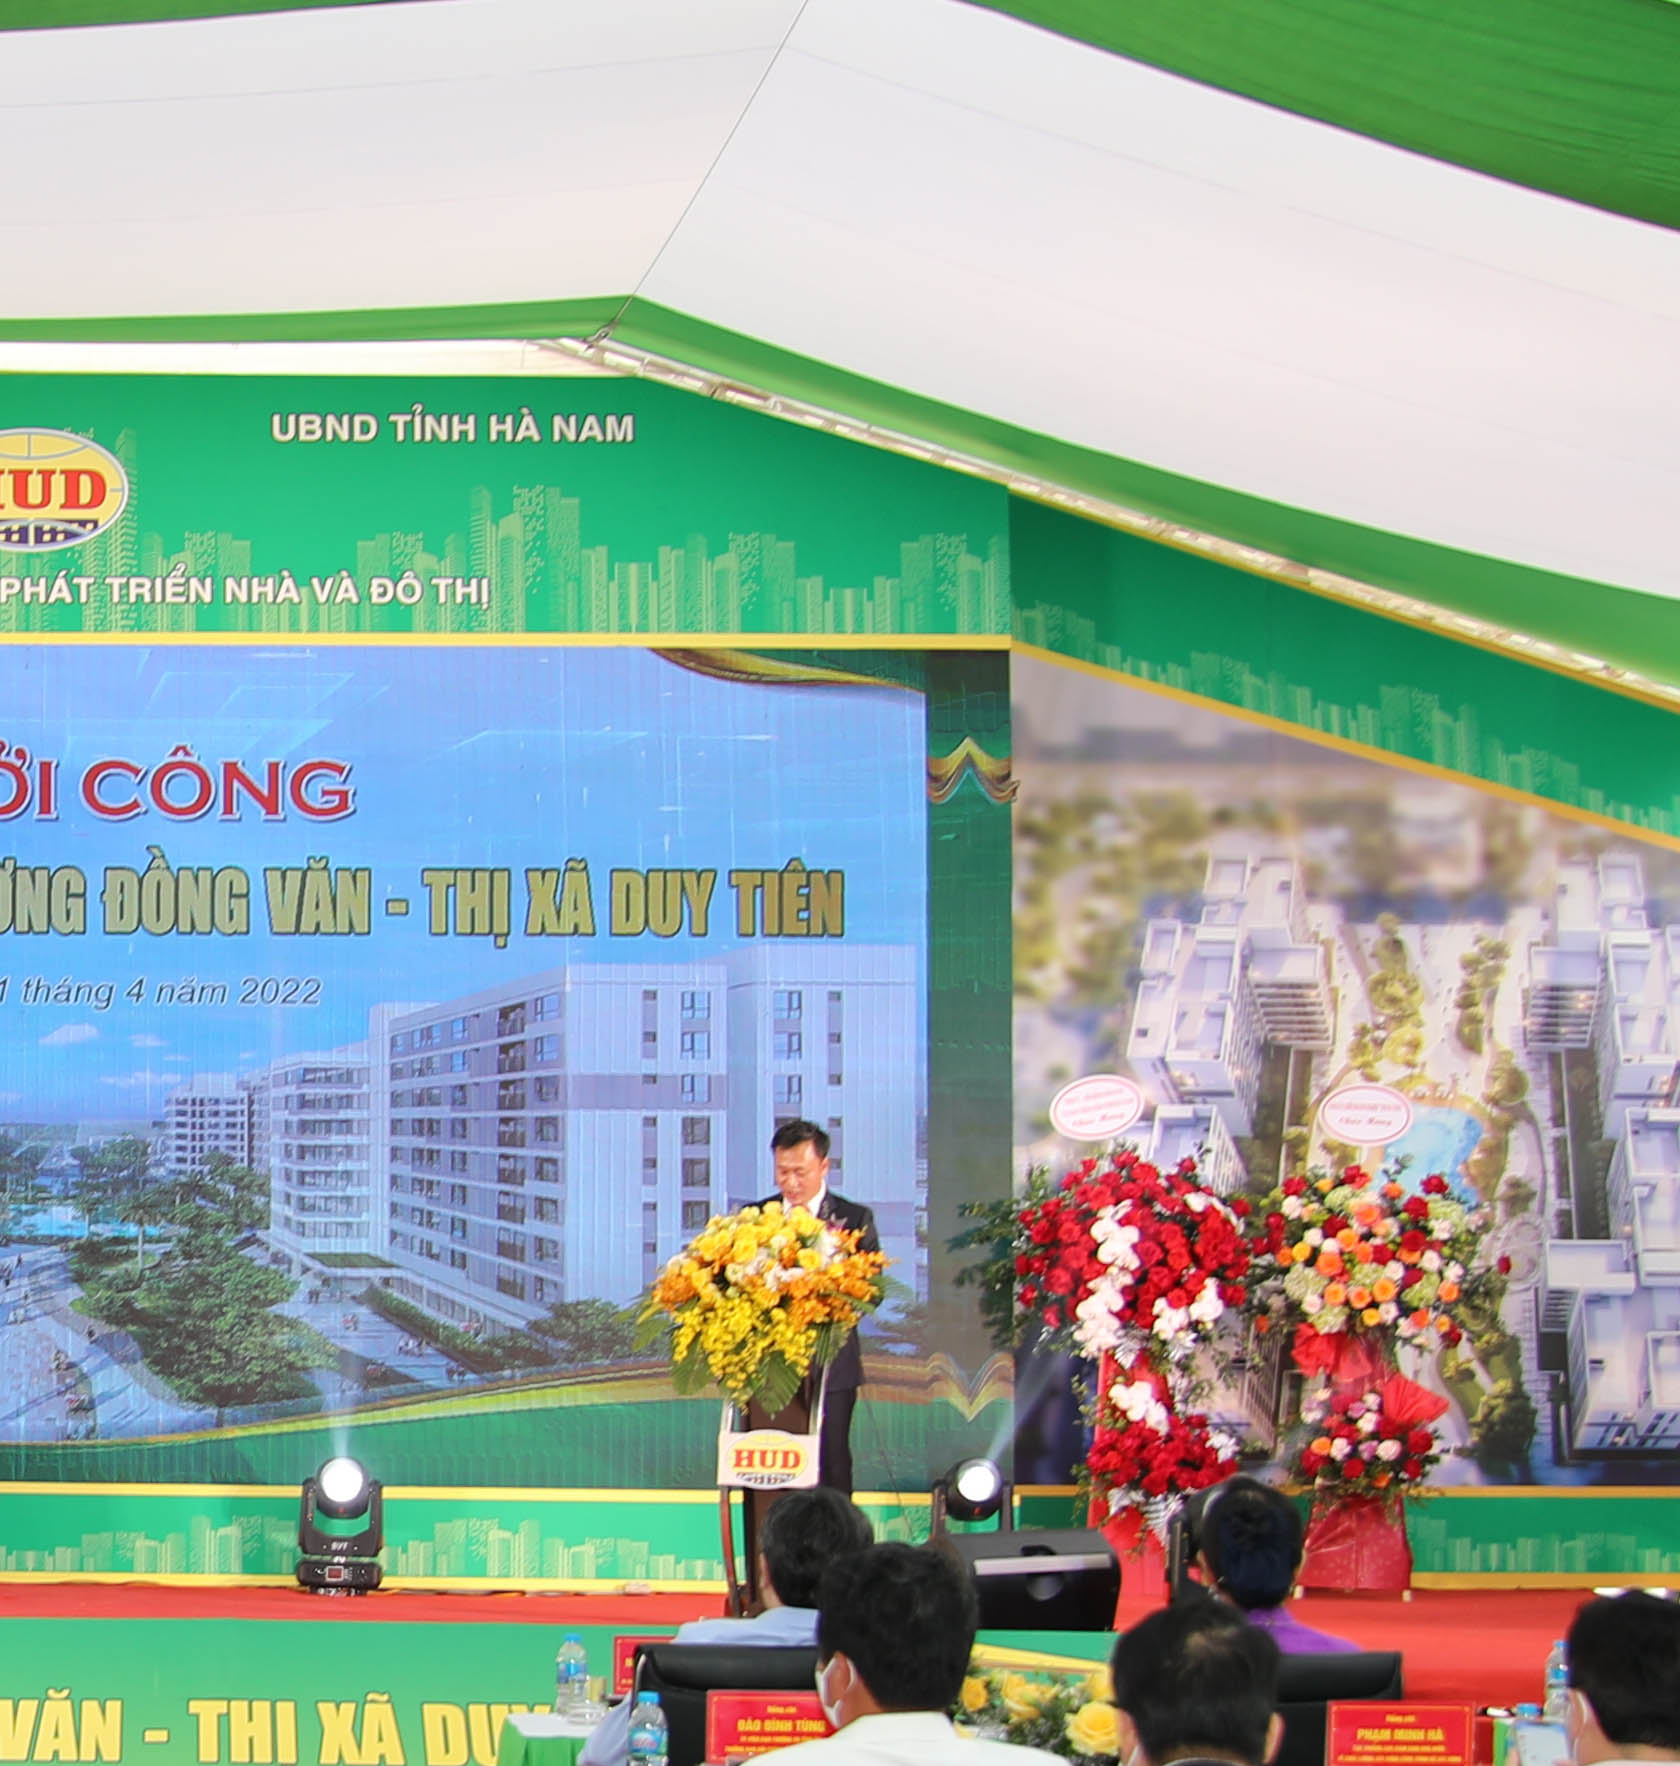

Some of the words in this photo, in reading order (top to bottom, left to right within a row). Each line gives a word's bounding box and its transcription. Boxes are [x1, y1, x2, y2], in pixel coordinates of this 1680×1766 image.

[270, 412, 379, 443] UBND
[389, 403, 477, 444] TỈNH
[488, 406, 542, 444] HÀ
[552, 413, 637, 444] NAM
[1, 568, 95, 605] PHÁT
[104, 562, 214, 605] TRIỂN
[224, 568, 302, 605] NHÀ
[310, 568, 361, 605] VÀ
[370, 570, 424, 605] ĐÔ
[431, 575, 492, 611] THỊ
[81, 743, 357, 823] CÔNG
[101, 845, 250, 936] ĐỒNG
[264, 855, 372, 936] VĂN
[422, 867, 511, 948] THỊ
[525, 857, 596, 936] XÃ
[609, 868, 716, 937] DUY
[729, 857, 846, 937] TIÊN
[21, 975, 114, 1011] tháng
[125, 976, 146, 1003] 4
[152, 975, 231, 1004] năm
[239, 976, 323, 1004] 2022
[733, 1449, 801, 1469] HUD
